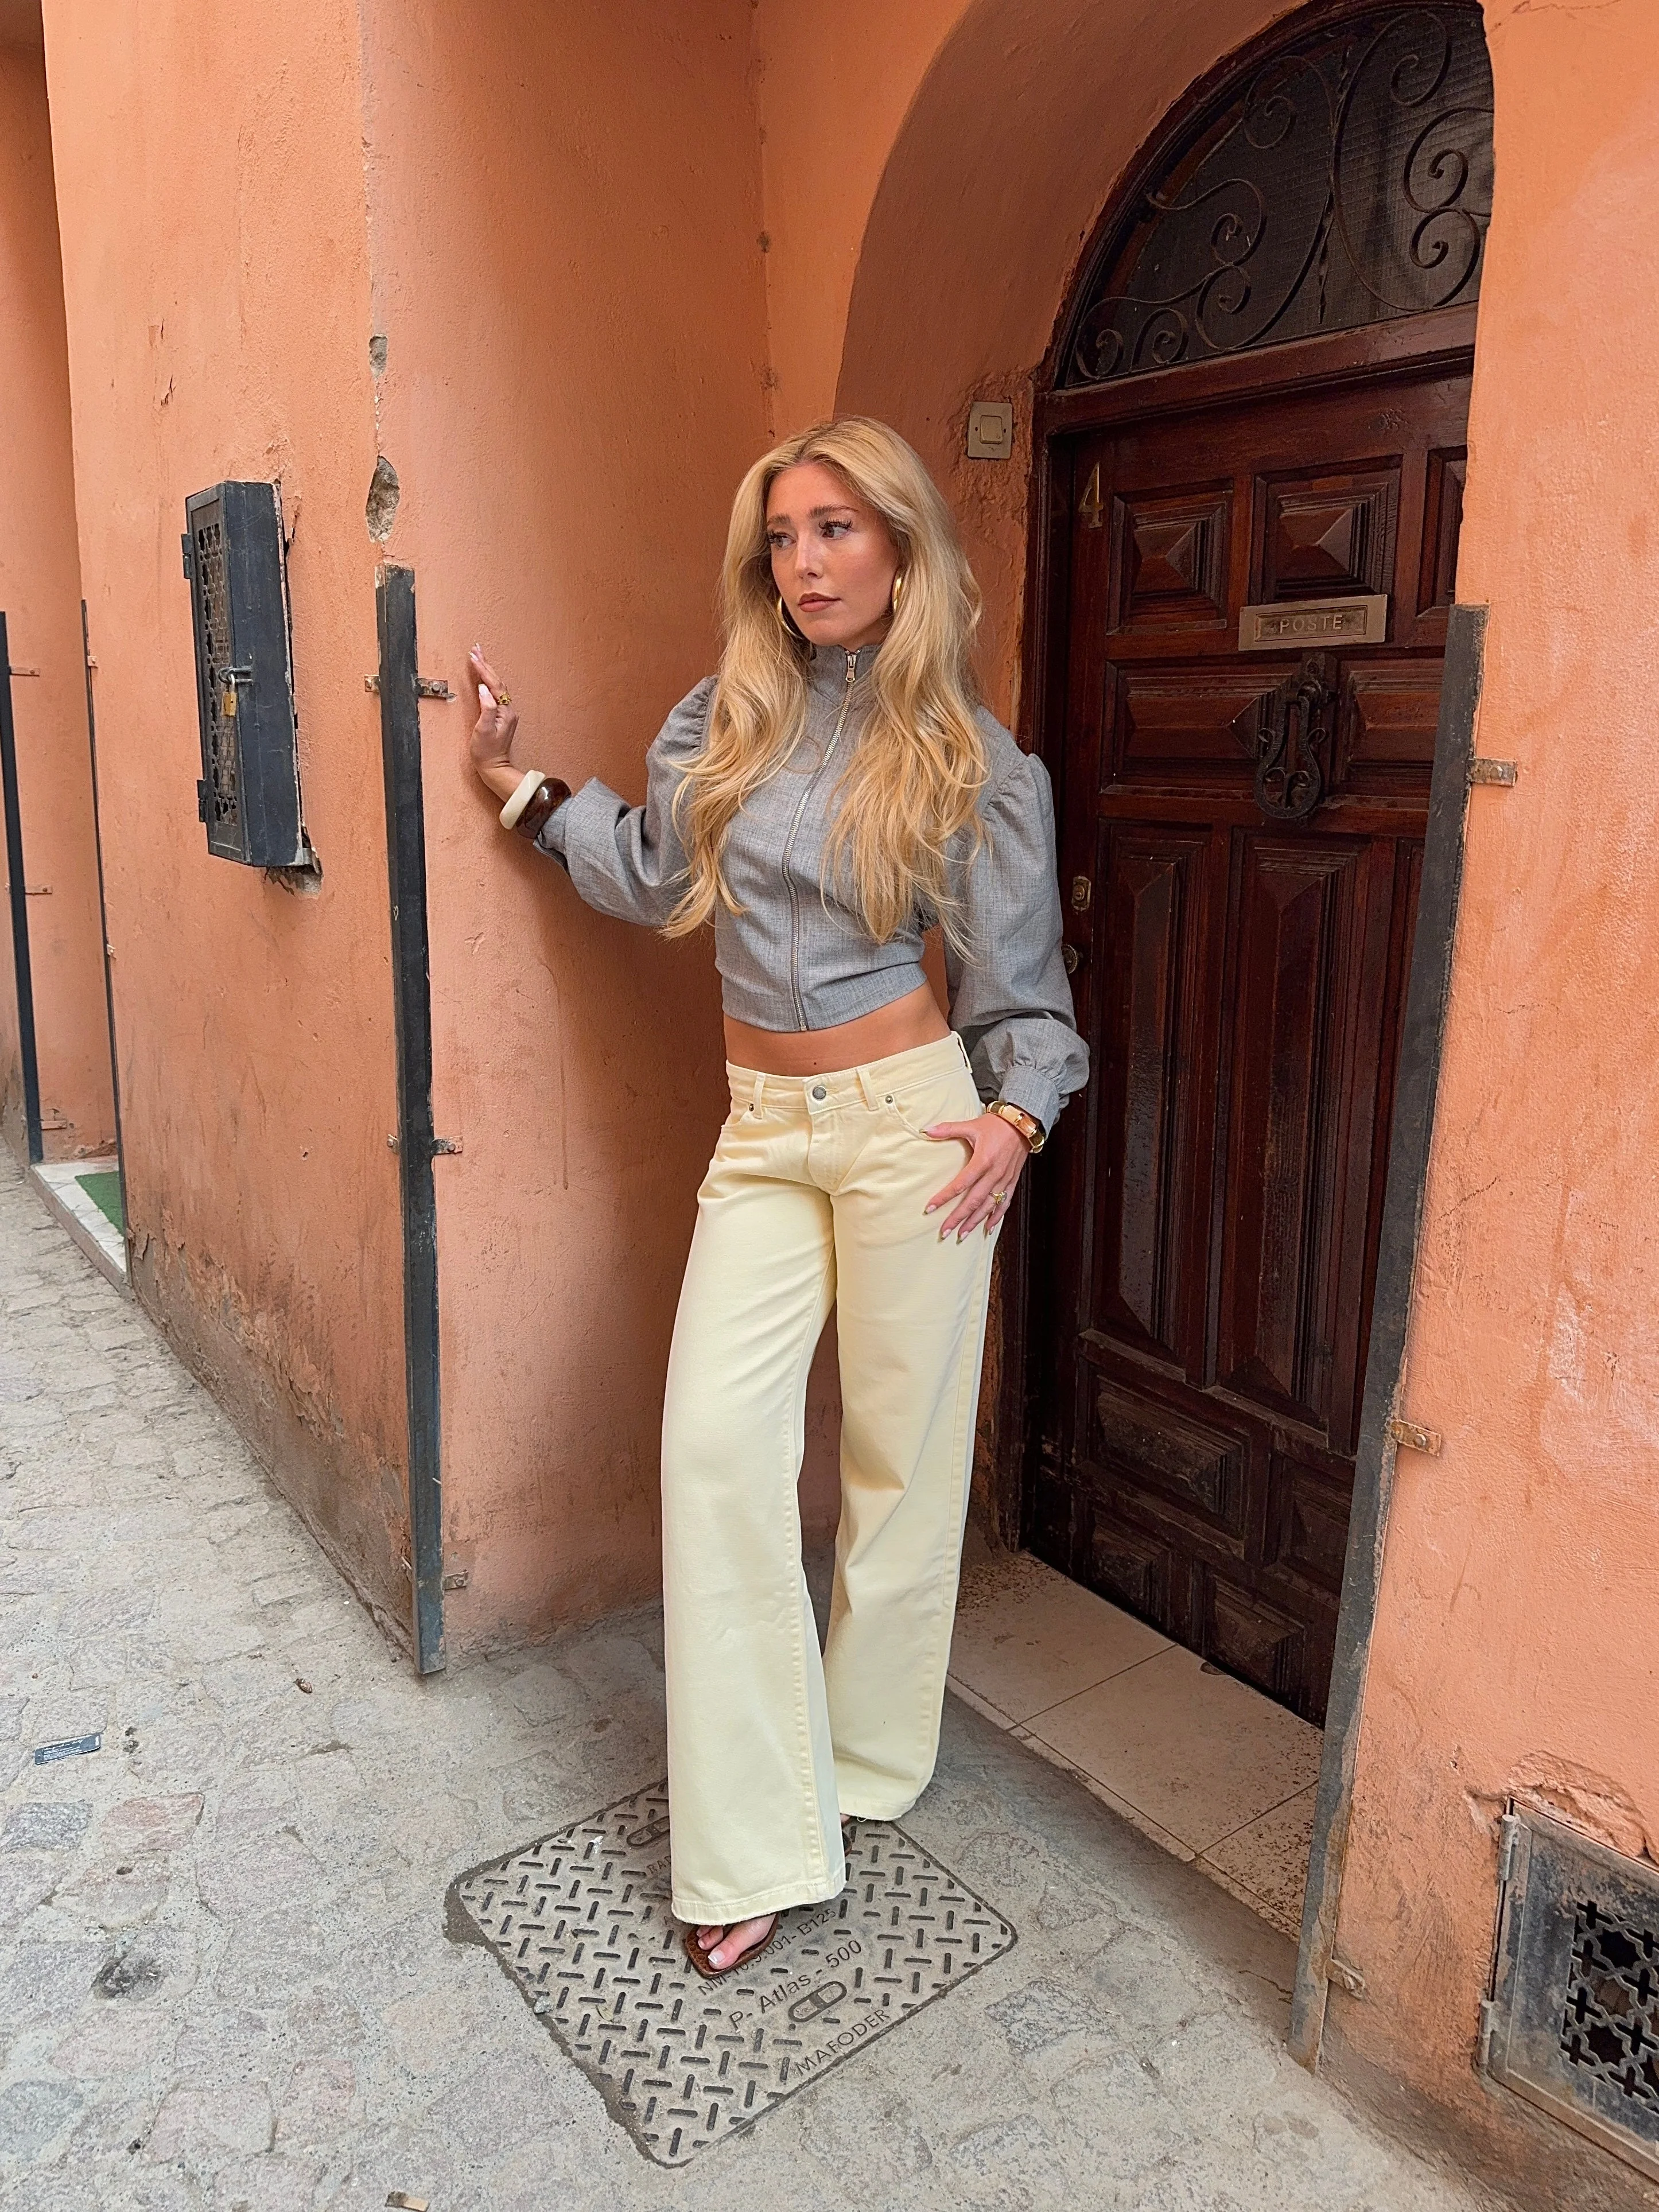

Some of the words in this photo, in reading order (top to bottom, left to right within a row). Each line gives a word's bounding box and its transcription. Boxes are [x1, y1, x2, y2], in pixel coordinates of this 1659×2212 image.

[1078, 461, 1104, 528] 4
[1279, 614, 1343, 633] POSTE
[759, 1975, 811, 2014] Atlas
[826, 1940, 861, 1968] 500
[795, 2009, 890, 2075] MAFODER
